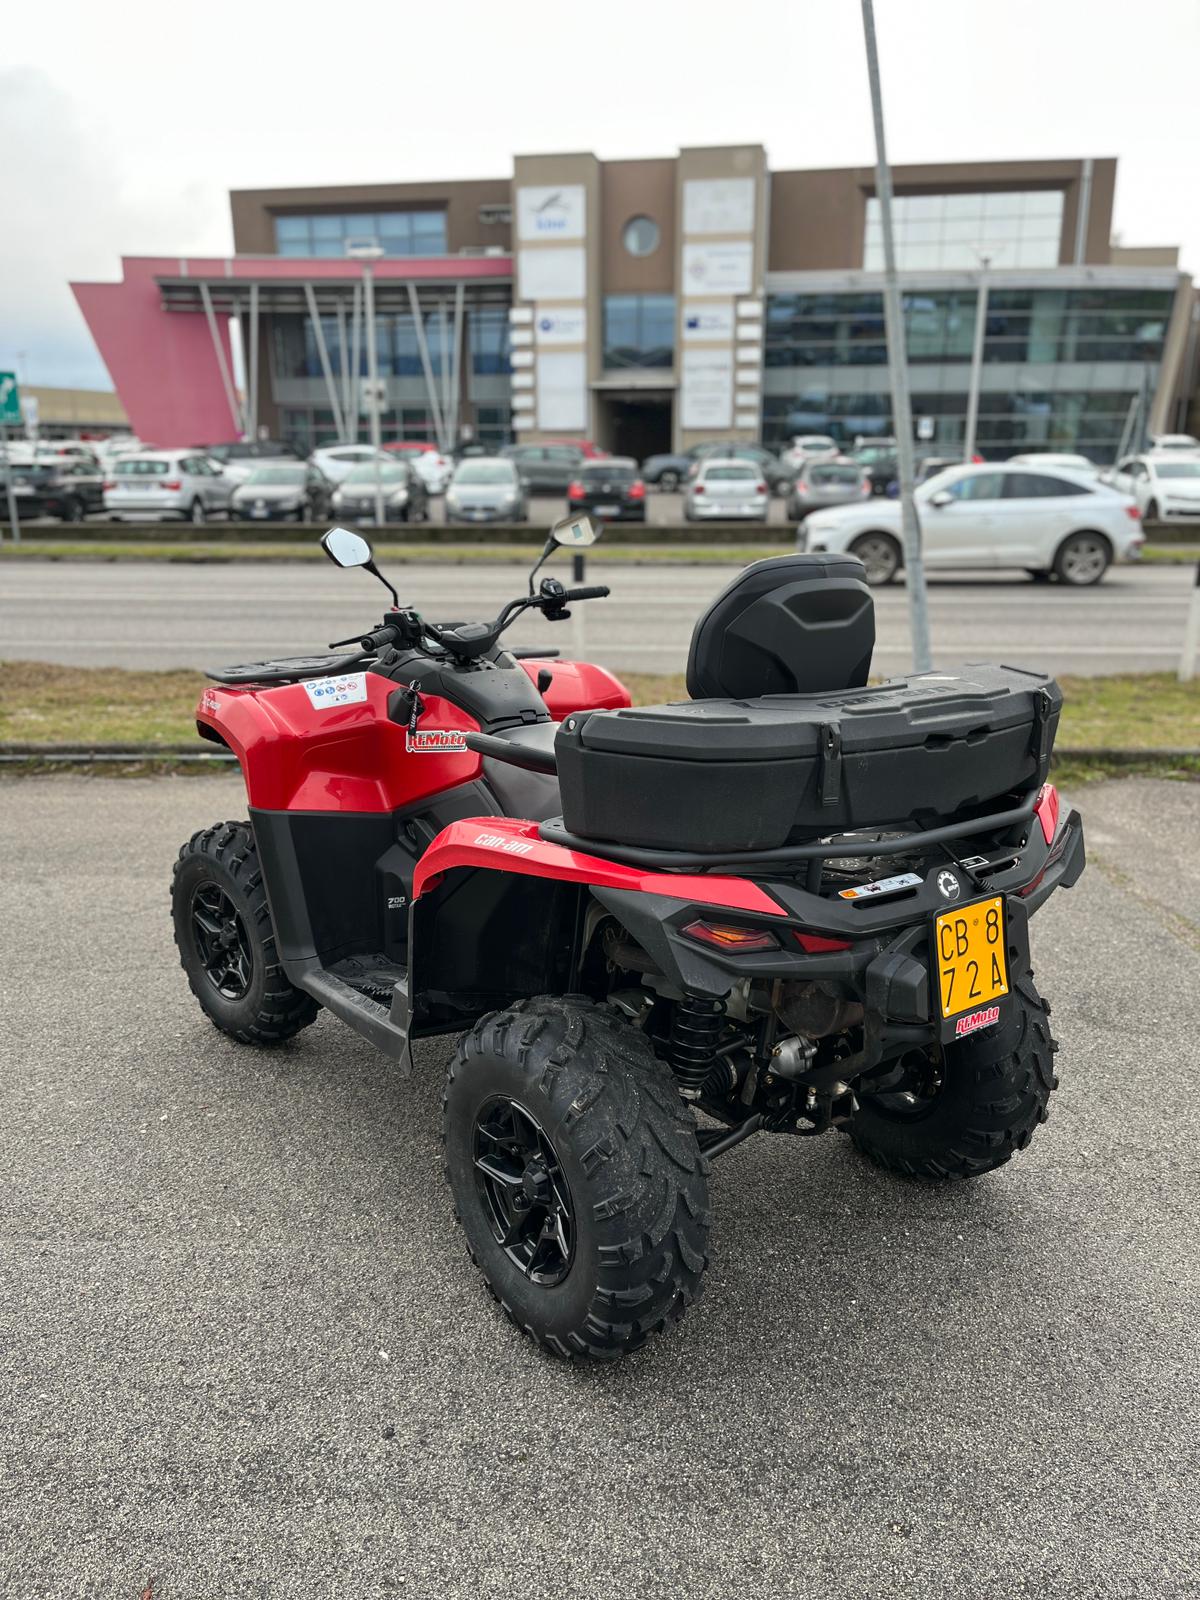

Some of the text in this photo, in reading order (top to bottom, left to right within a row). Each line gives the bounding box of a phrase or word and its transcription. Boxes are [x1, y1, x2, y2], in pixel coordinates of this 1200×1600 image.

[473, 833, 534, 855] can-am
[388, 896, 405, 904] 700
[941, 919, 968, 961] CB
